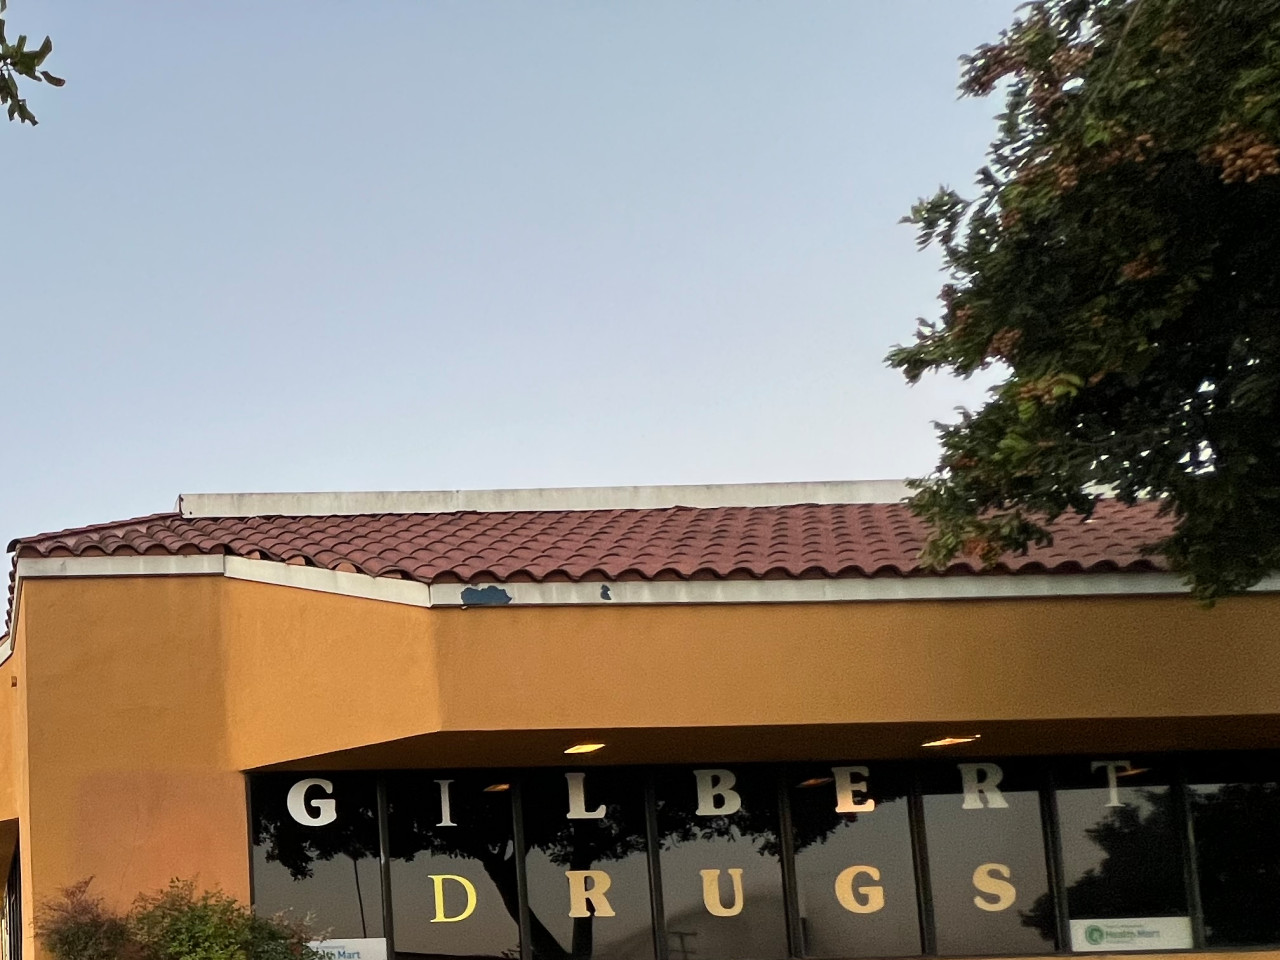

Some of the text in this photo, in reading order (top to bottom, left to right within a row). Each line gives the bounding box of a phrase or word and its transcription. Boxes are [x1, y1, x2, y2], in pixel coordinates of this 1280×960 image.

[286, 760, 1132, 827] GILBERT
[428, 863, 1017, 923] DRUGS
[337, 950, 361, 959] Mart
